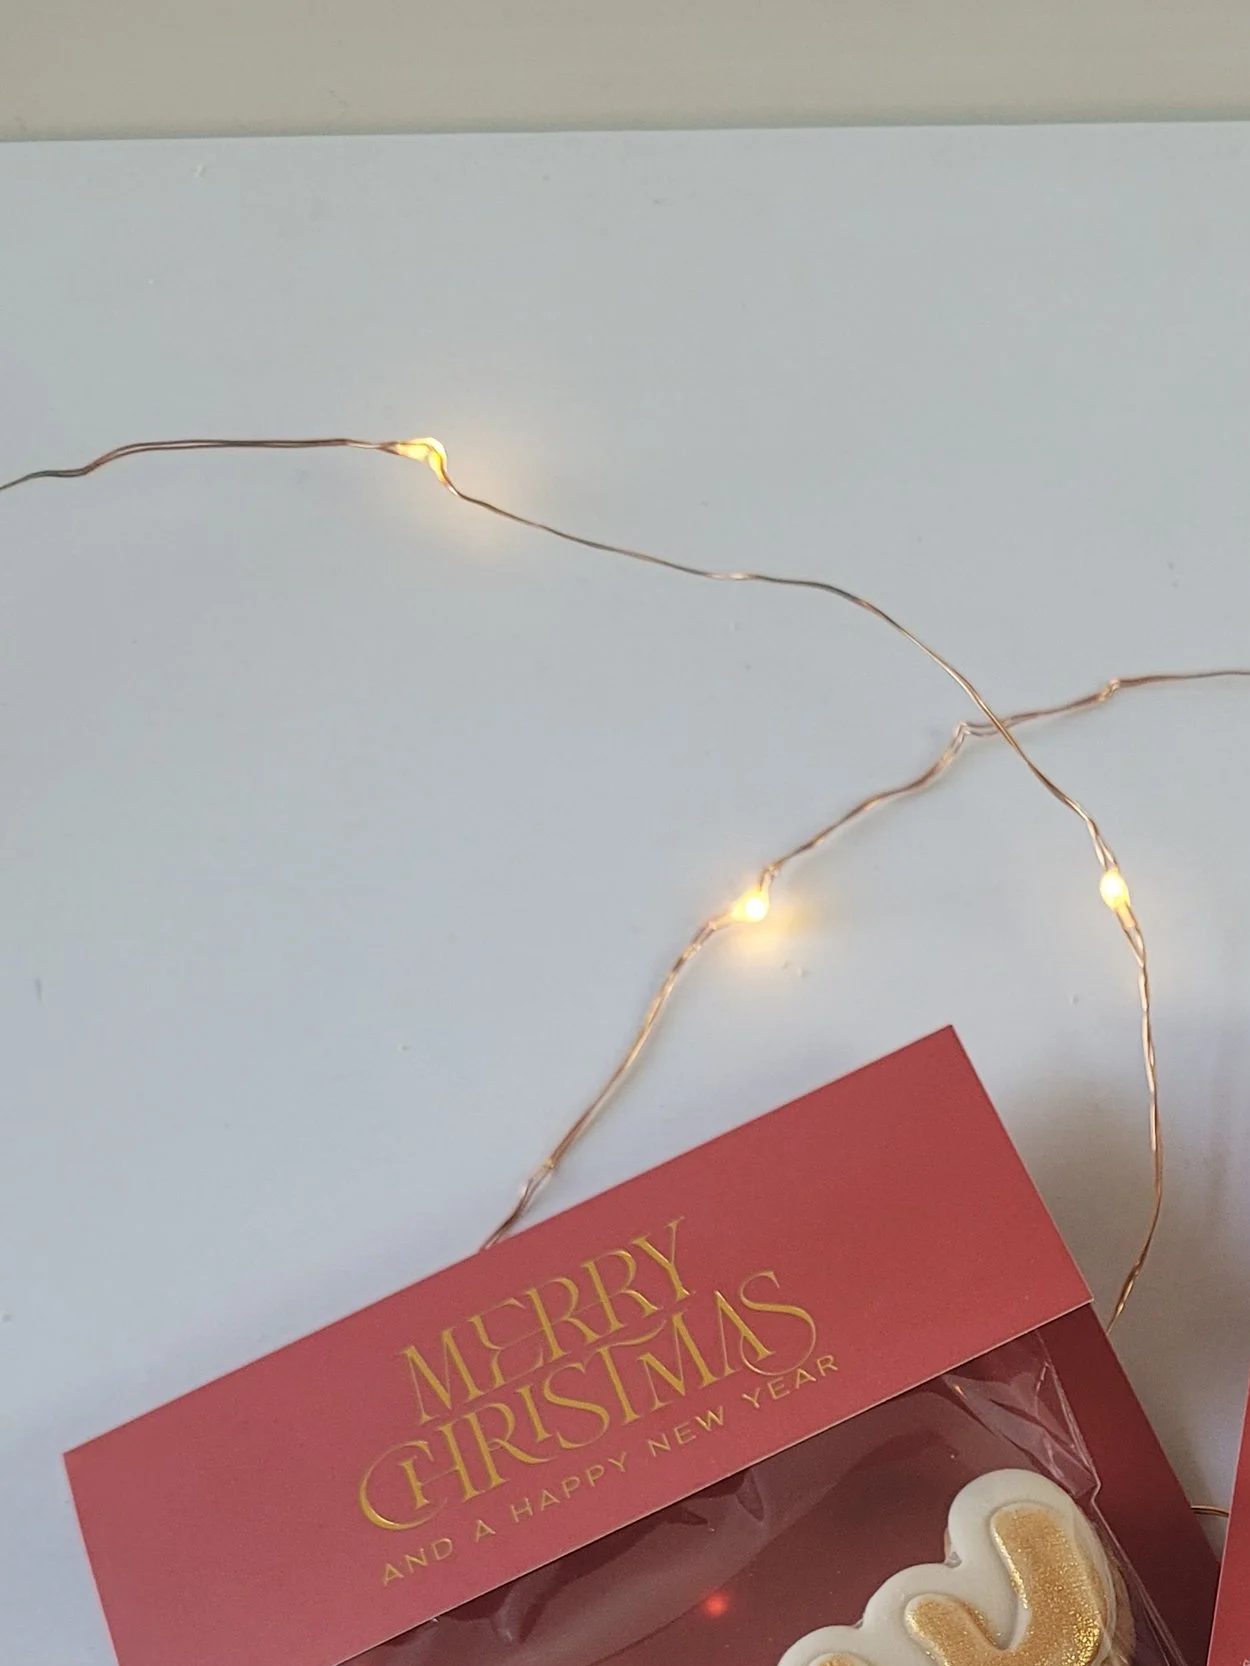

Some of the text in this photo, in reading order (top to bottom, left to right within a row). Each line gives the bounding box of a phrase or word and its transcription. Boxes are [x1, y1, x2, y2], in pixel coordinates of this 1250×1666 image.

[359, 1271, 817, 1530] CHRISTMAS
[400, 1216, 696, 1425] MERRY
[383, 1355, 838, 1585] AND A HAPPY NEW YEAR
